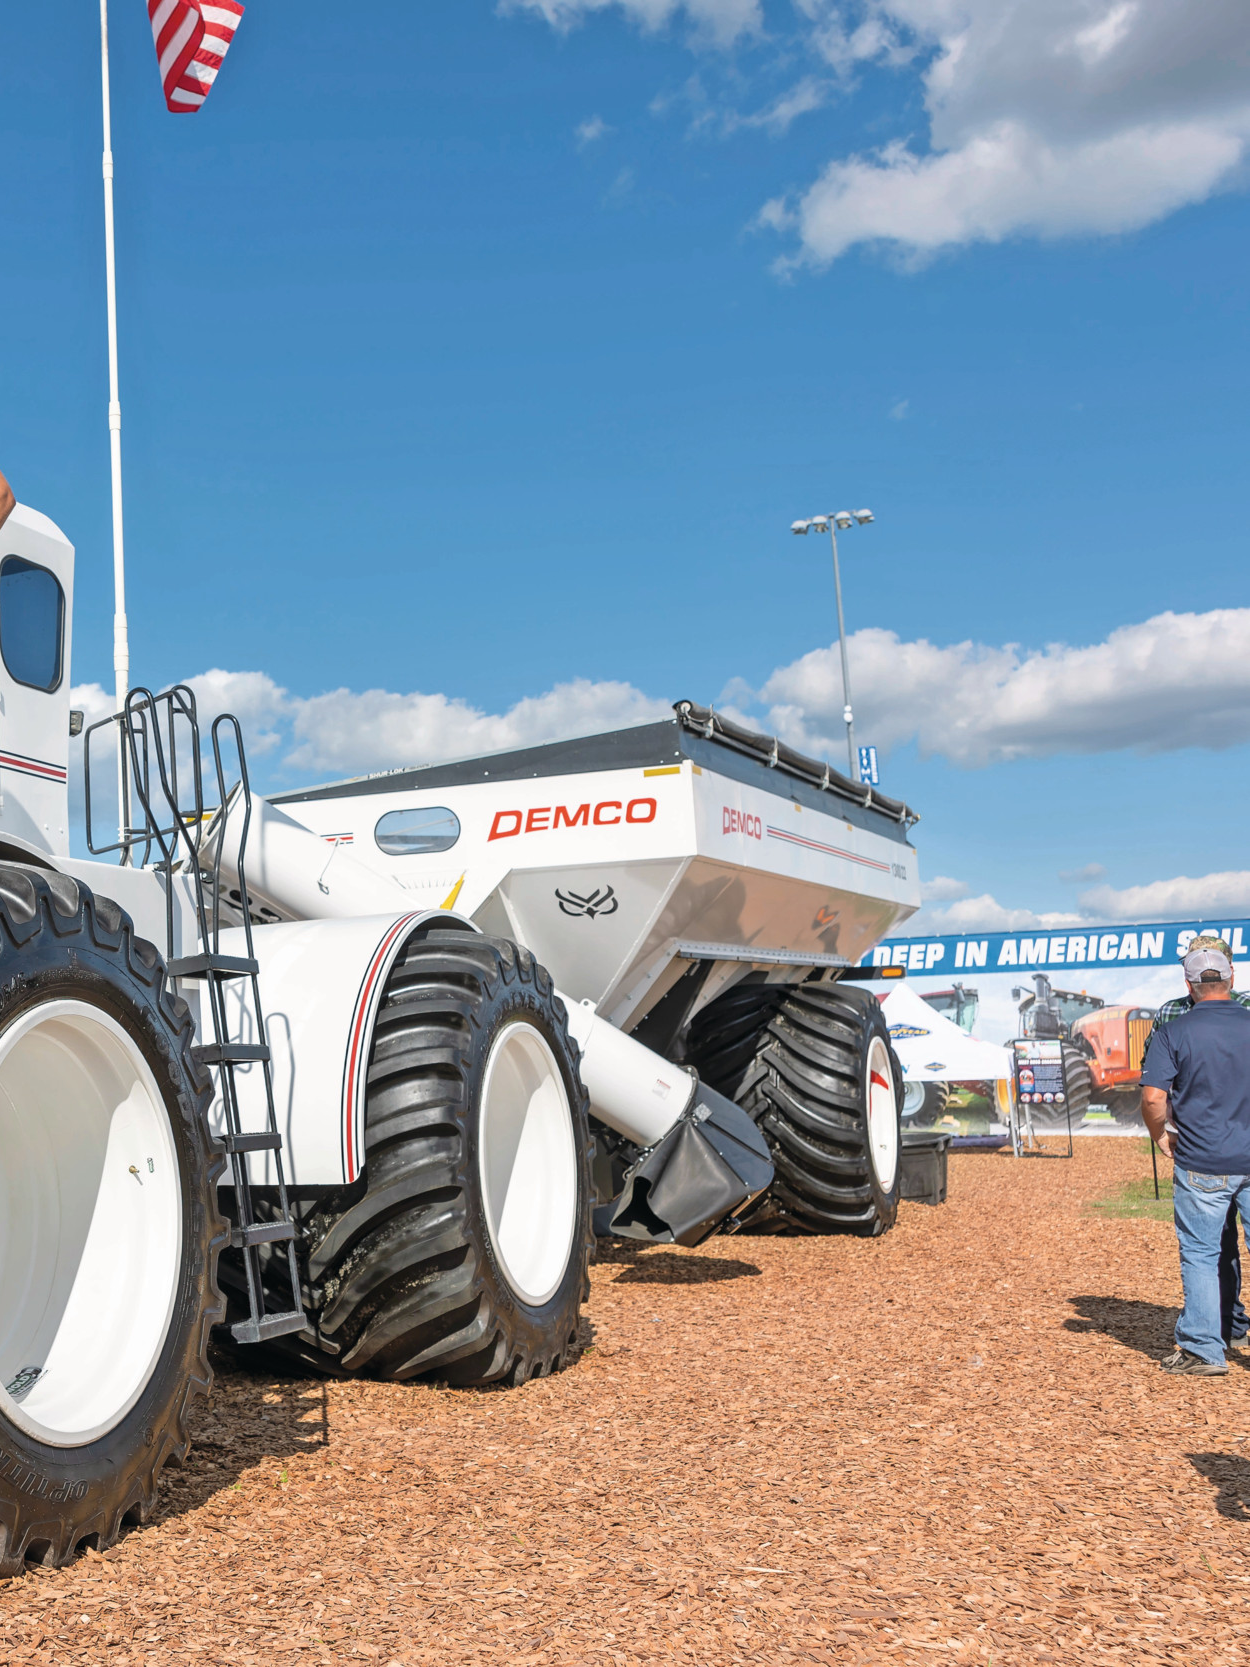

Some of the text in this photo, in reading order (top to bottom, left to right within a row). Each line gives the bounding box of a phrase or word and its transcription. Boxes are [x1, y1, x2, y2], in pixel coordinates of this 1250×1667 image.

[487, 797, 657, 842] DEMCO
[722, 806, 762, 840] DEMCO
[872, 942, 945, 971] DEEP
[954, 941, 989, 968] IN
[997, 931, 1165, 966] AMERICAN
